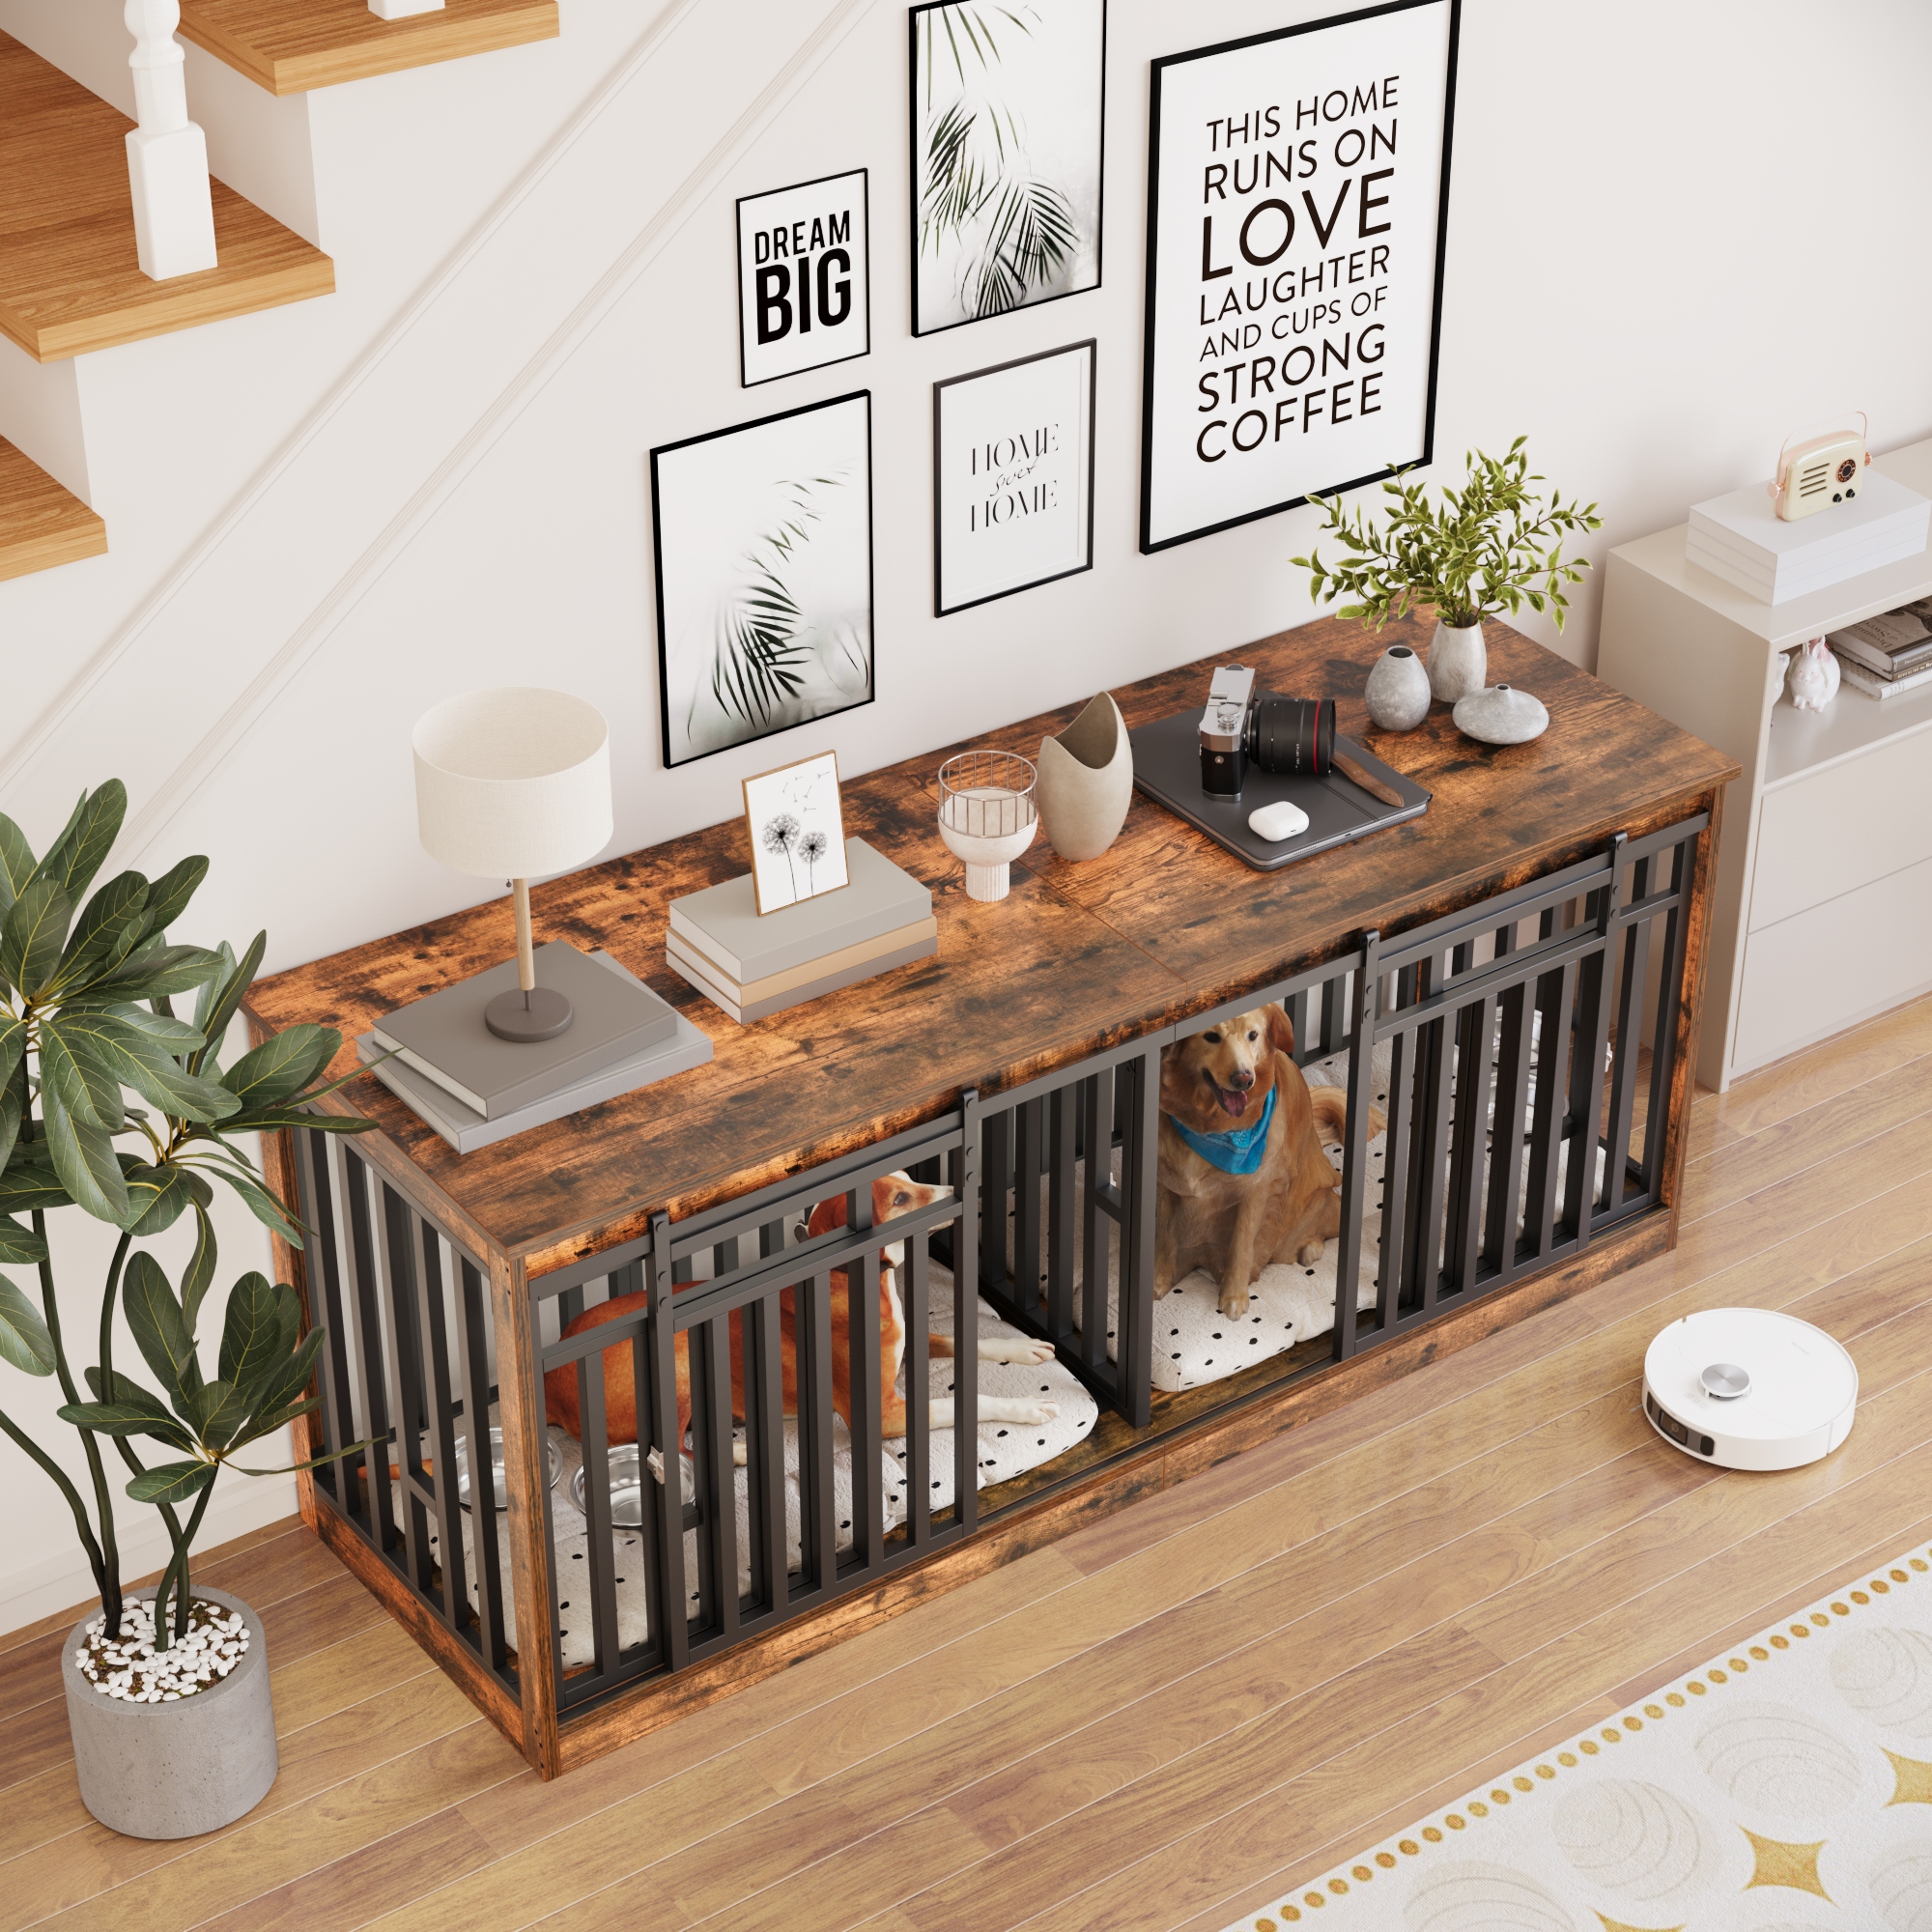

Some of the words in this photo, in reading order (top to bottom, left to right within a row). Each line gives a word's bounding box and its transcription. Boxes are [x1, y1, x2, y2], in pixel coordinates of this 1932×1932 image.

[1207, 105, 1281, 153] THIS
[1295, 75, 1400, 131] HOME
[1204, 139, 1318, 205] RUNS
[1334, 118, 1398, 168] ON
[754, 209, 850, 265] DREAM
[1201, 167, 1395, 282] LOVE
[755, 247, 851, 346] BIG
[1199, 323, 1262, 362] AND
[1271, 298, 1342, 340] CUPS
[1350, 285, 1388, 317] OF
[1200, 244, 1390, 327] LAUGHTER
[1197, 324, 1385, 412] STRONG
[972, 423, 1059, 475] HOME
[1197, 371, 1383, 463] COFFEE
[971, 479, 1058, 532] HOME
[1851, 623, 1892, 648] Dreamin
